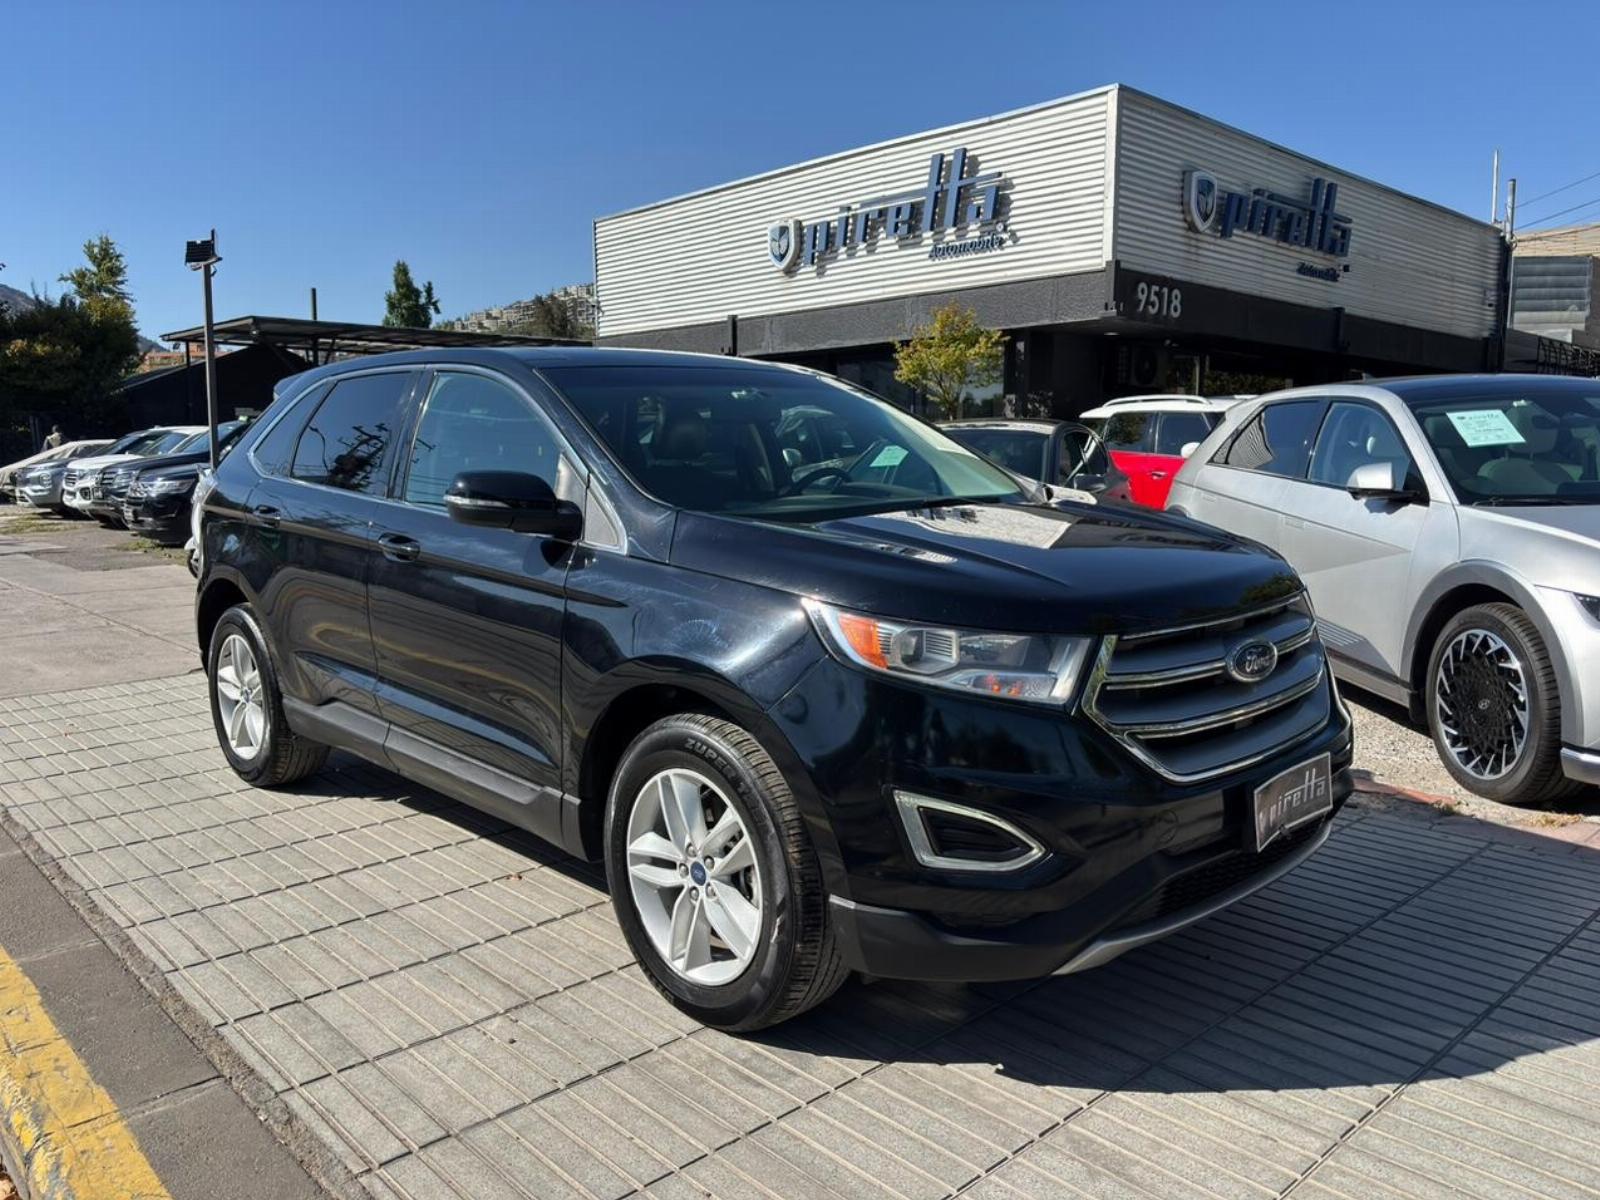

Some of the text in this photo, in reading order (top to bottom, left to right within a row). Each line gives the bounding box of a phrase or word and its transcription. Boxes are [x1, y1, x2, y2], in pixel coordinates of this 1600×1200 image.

[803, 147, 1002, 266] piretta
[1220, 177, 1352, 257] piretta
[1137, 282, 1181, 318] 9518
